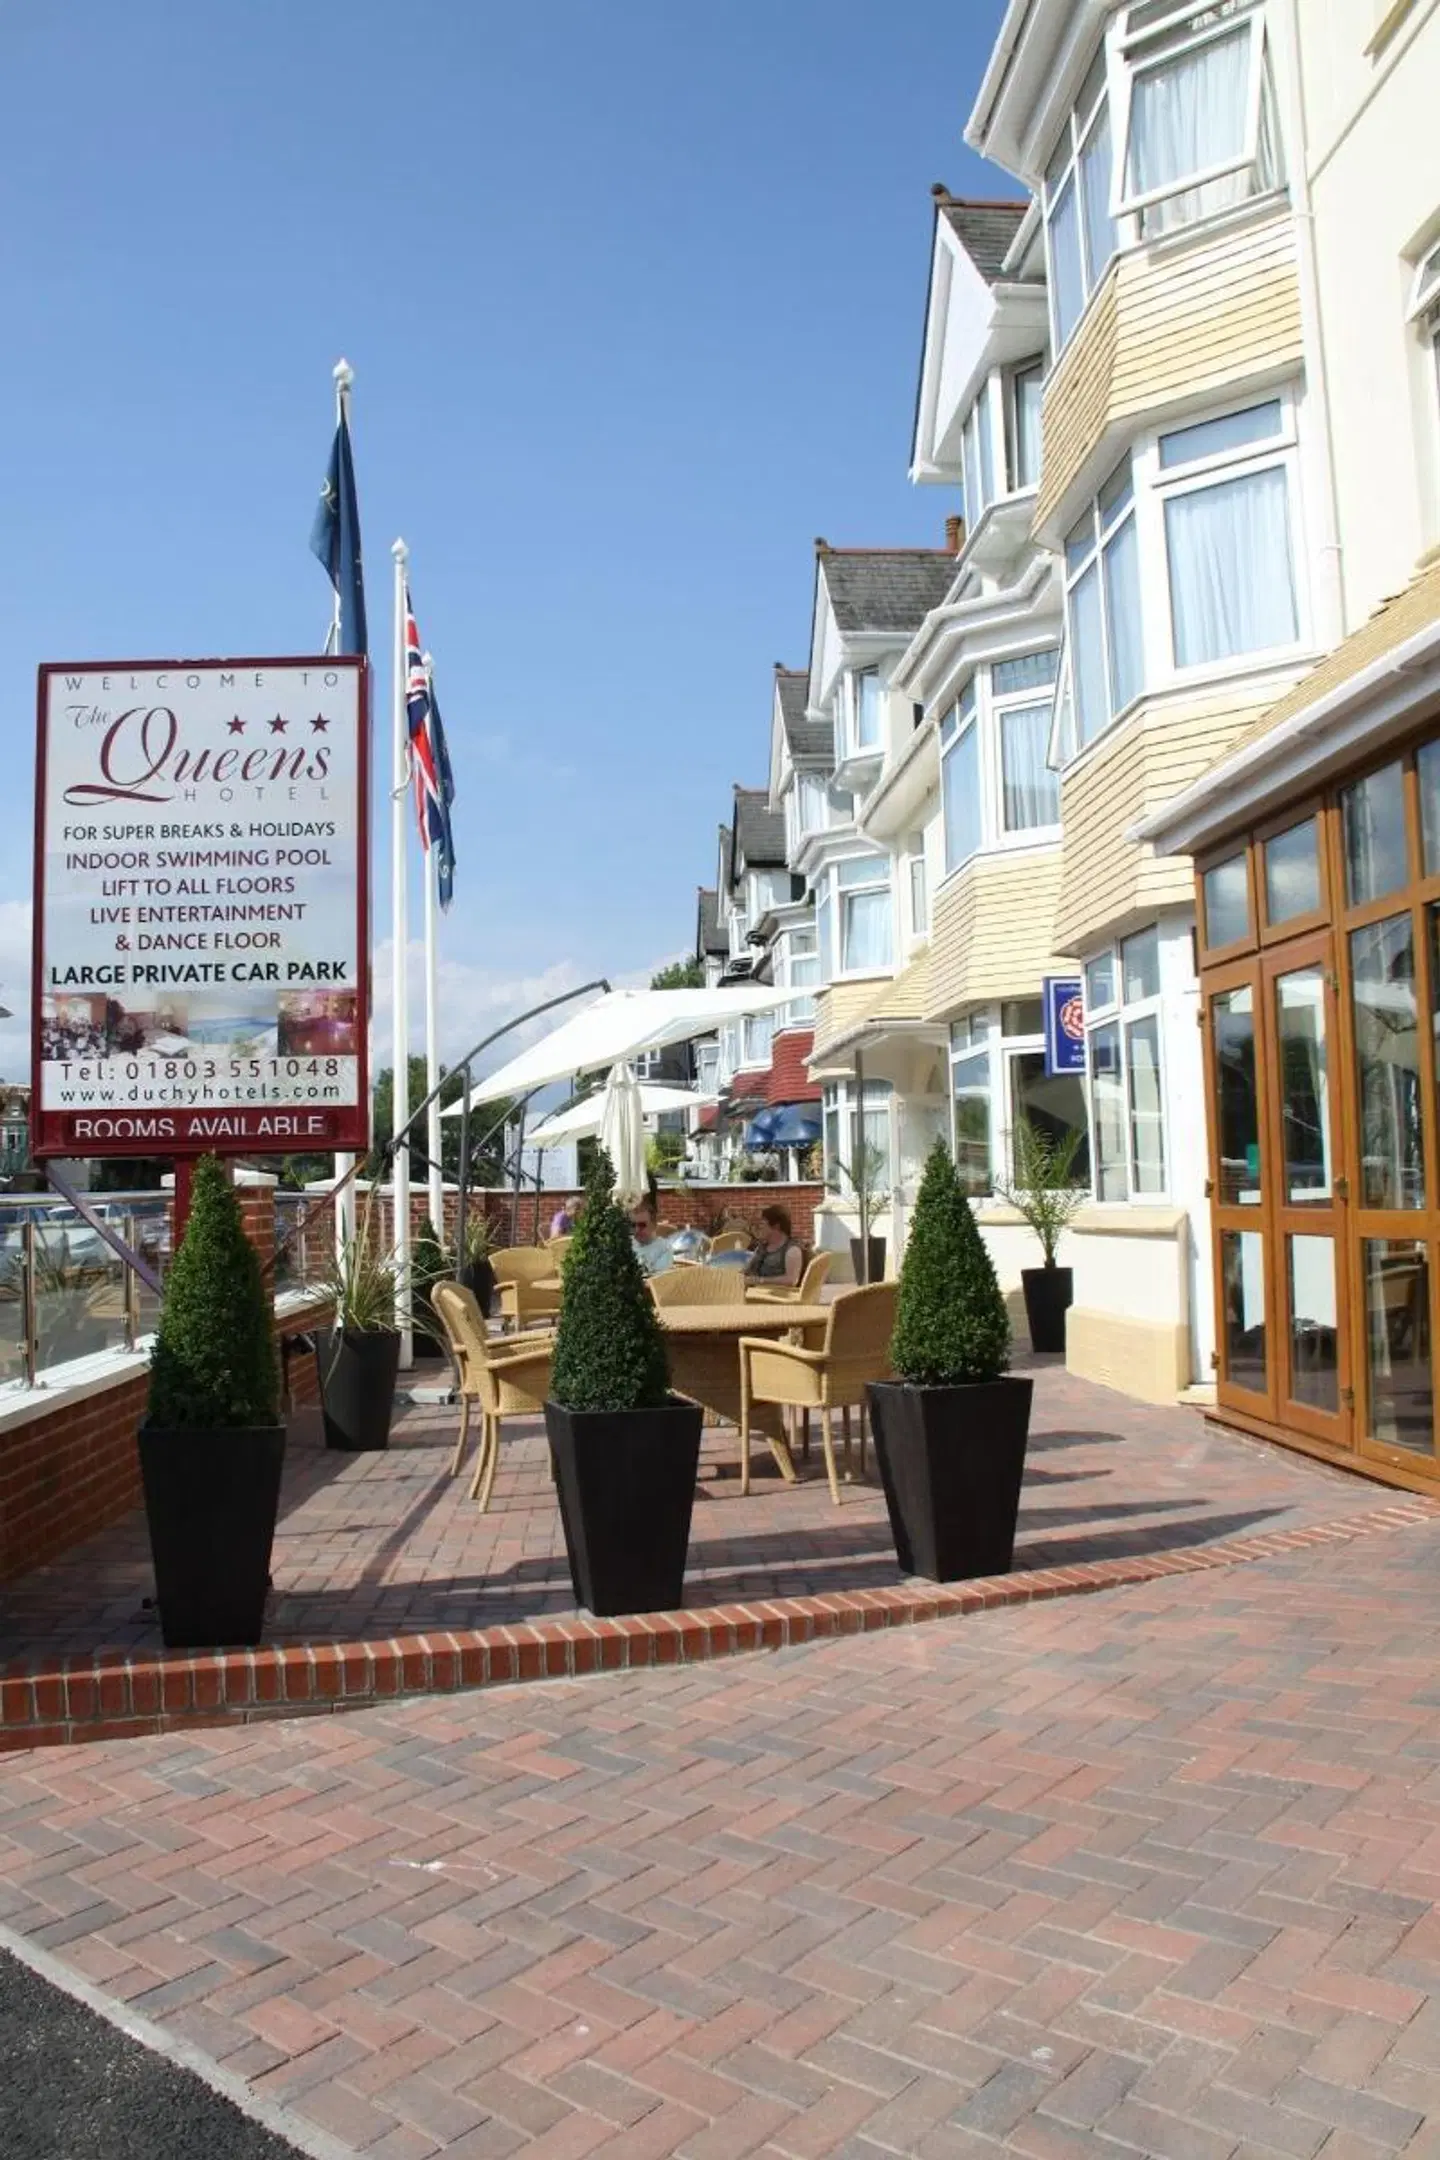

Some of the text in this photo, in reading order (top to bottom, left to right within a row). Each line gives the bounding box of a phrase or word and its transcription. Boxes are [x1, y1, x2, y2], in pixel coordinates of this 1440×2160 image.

[65, 671, 338, 691] WELCOME TO
[64, 705, 111, 729] The
[62, 707, 331, 806] Queens
[184, 787, 329, 802] HOTEL
[63, 822, 335, 840] FOR SUPER BREAKS & HOLIDAYS
[66, 849, 331, 870] INDOOR SWIMMING POOL
[102, 876, 294, 896] LIFT TO ALL FLOORS
[90, 903, 307, 924] LIVE ENTERTAINMENT
[115, 932, 281, 951] & DANCE FLOOR
[51, 961, 347, 985] LARGE PRIVATE CAR PARK
[61, 1058, 339, 1081] Tel: 01803 551048
[61, 1083, 340, 1104] www.duchyhotels.com
[75, 1117, 176, 1138] ROOMS
